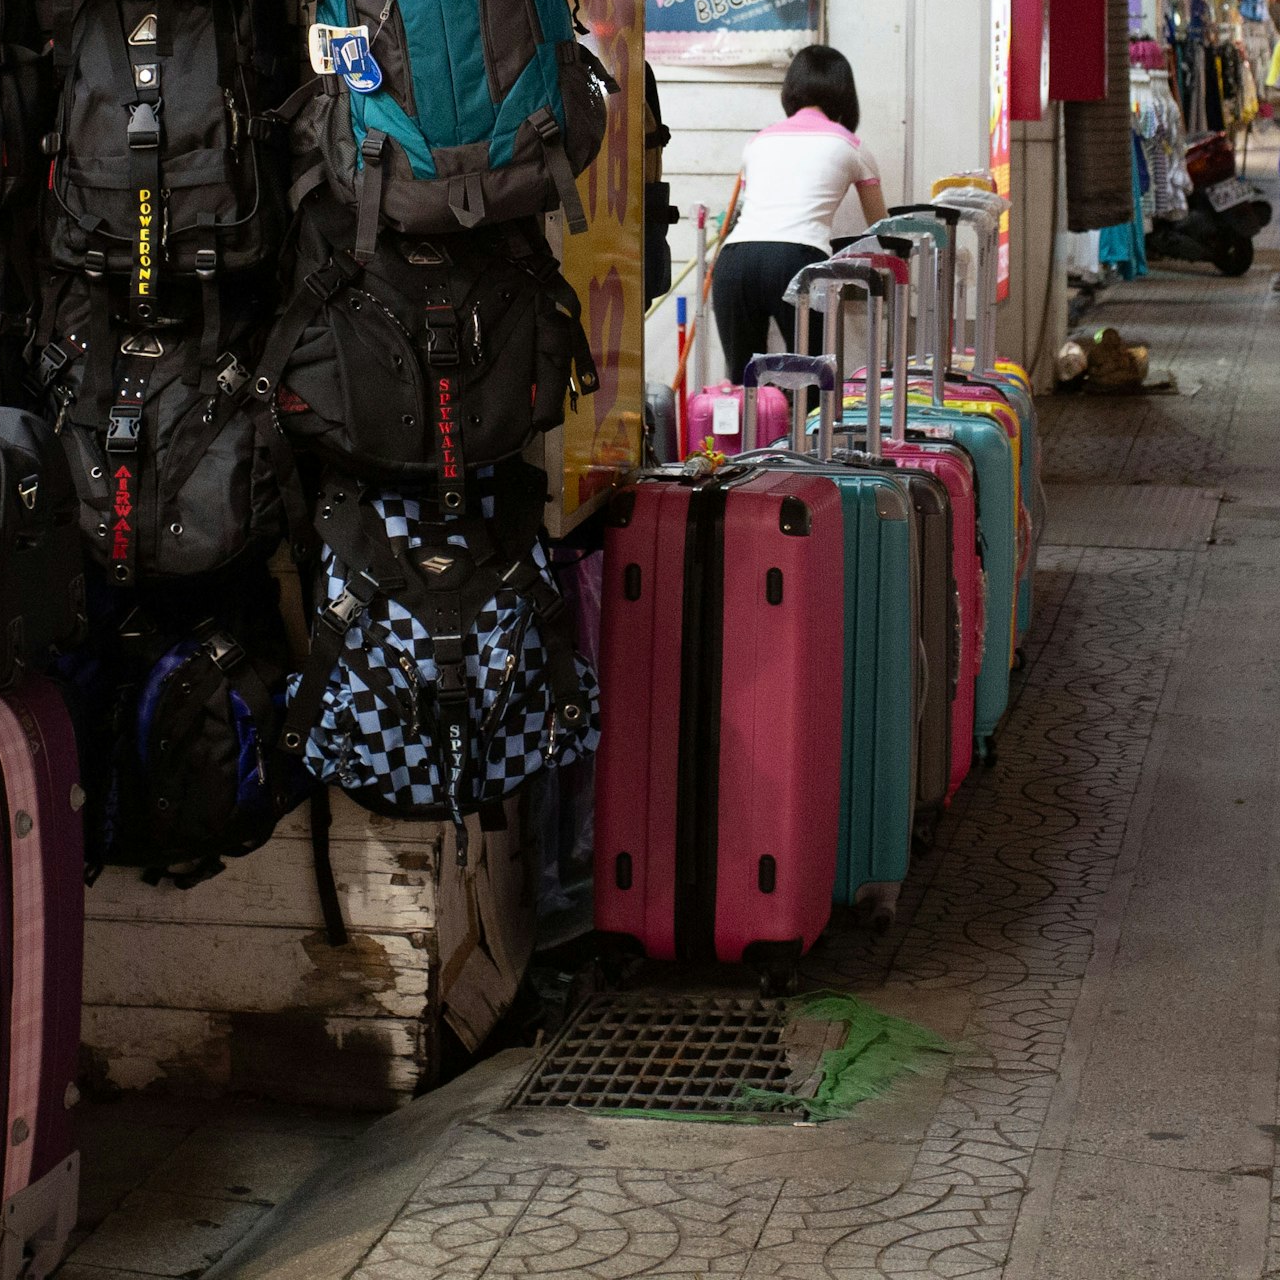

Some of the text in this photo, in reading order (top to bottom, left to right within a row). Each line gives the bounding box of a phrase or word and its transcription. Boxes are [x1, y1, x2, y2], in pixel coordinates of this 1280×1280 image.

[138, 189, 152, 295] POWERONE
[438, 378, 458, 478] SPYWALK
[112, 465, 133, 560] AIRWALK
[448, 724, 462, 825] SPYWALK
